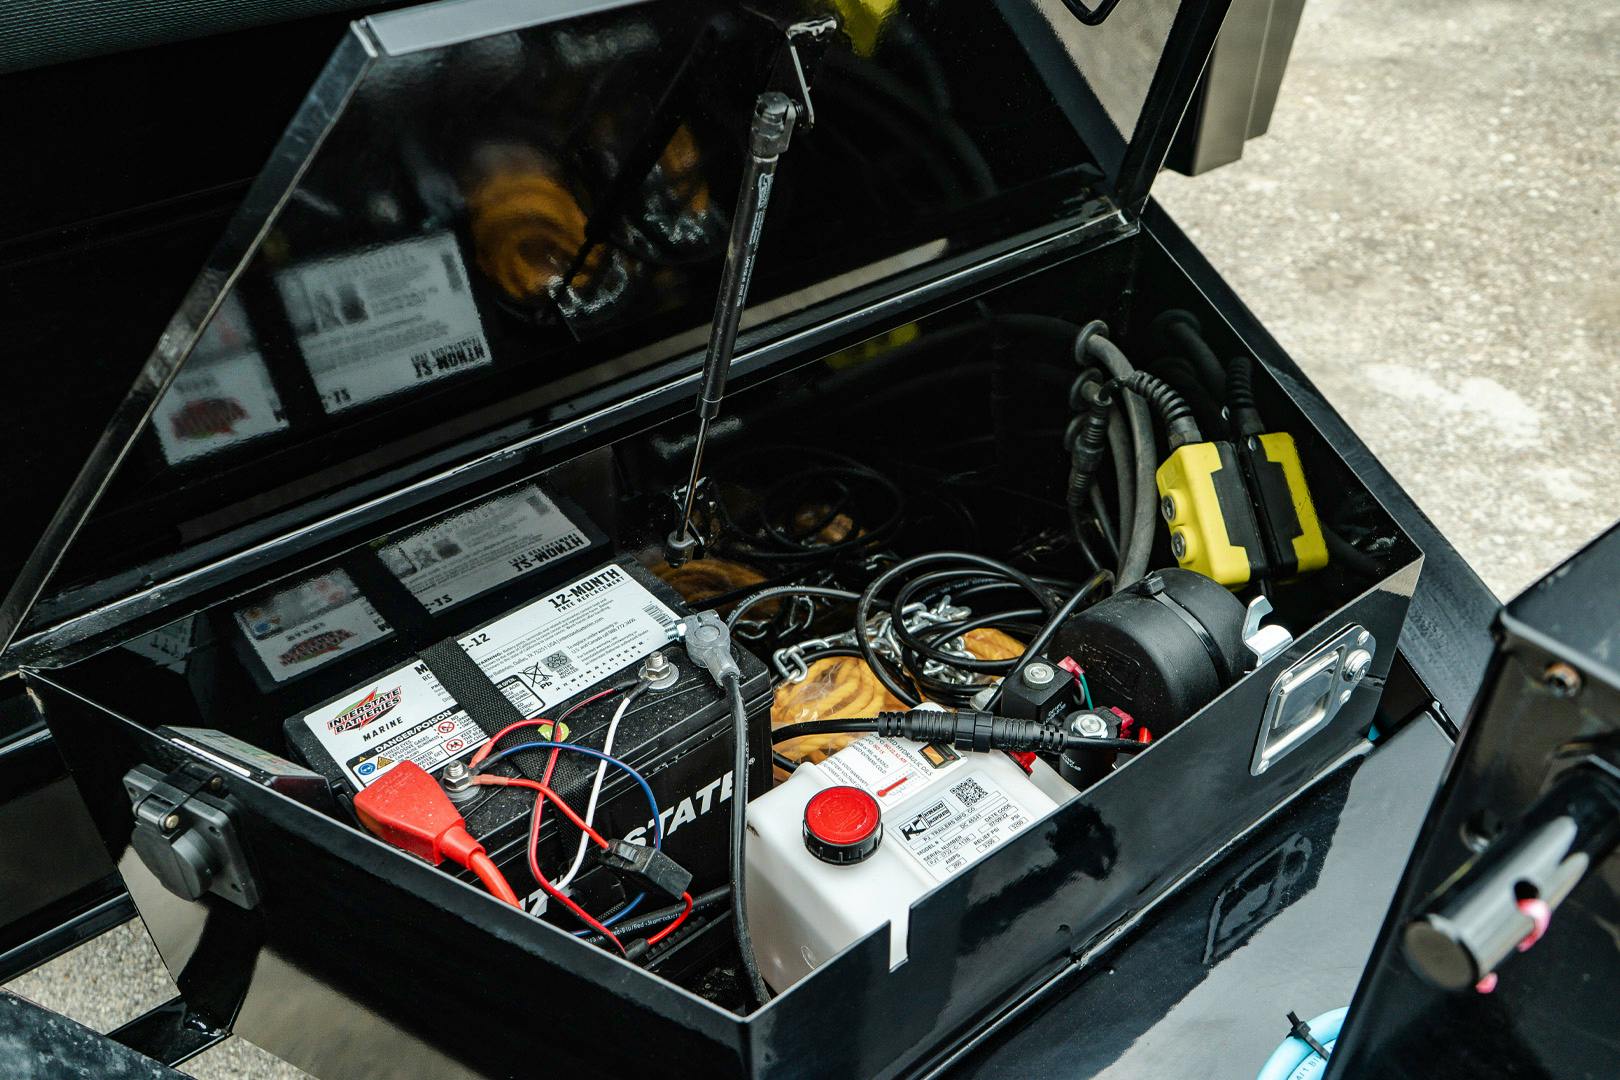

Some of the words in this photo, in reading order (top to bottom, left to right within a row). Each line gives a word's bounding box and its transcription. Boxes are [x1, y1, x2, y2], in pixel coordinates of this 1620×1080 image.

[548, 569, 620, 609] 12-MONTH
[557, 601, 575, 613] FREE
[577, 576, 624, 602] REPLACEMENT
[538, 680, 553, 689] Pb
[328, 687, 400, 727] INTERSTATE
[335, 696, 400, 732] BATTERIES
[362, 716, 403, 741] MARINE
[376, 711, 452, 753] DANGER/POISON
[461, 730, 472, 738] KEEP
[383, 746, 400, 756] SHIELD
[896, 744, 922, 767] HYDRAULIC
[922, 848, 942, 861] SERIAL
[940, 834, 963, 850] NUMBER
[983, 811, 999, 822] DATE
[996, 803, 1011, 813] CODE
[930, 819, 955, 836] TRAILERS
[916, 842, 936, 856] MODEL
[943, 852, 961, 864] AMPS
[972, 832, 991, 845] RELIEF
[989, 826, 1000, 834] PSI
